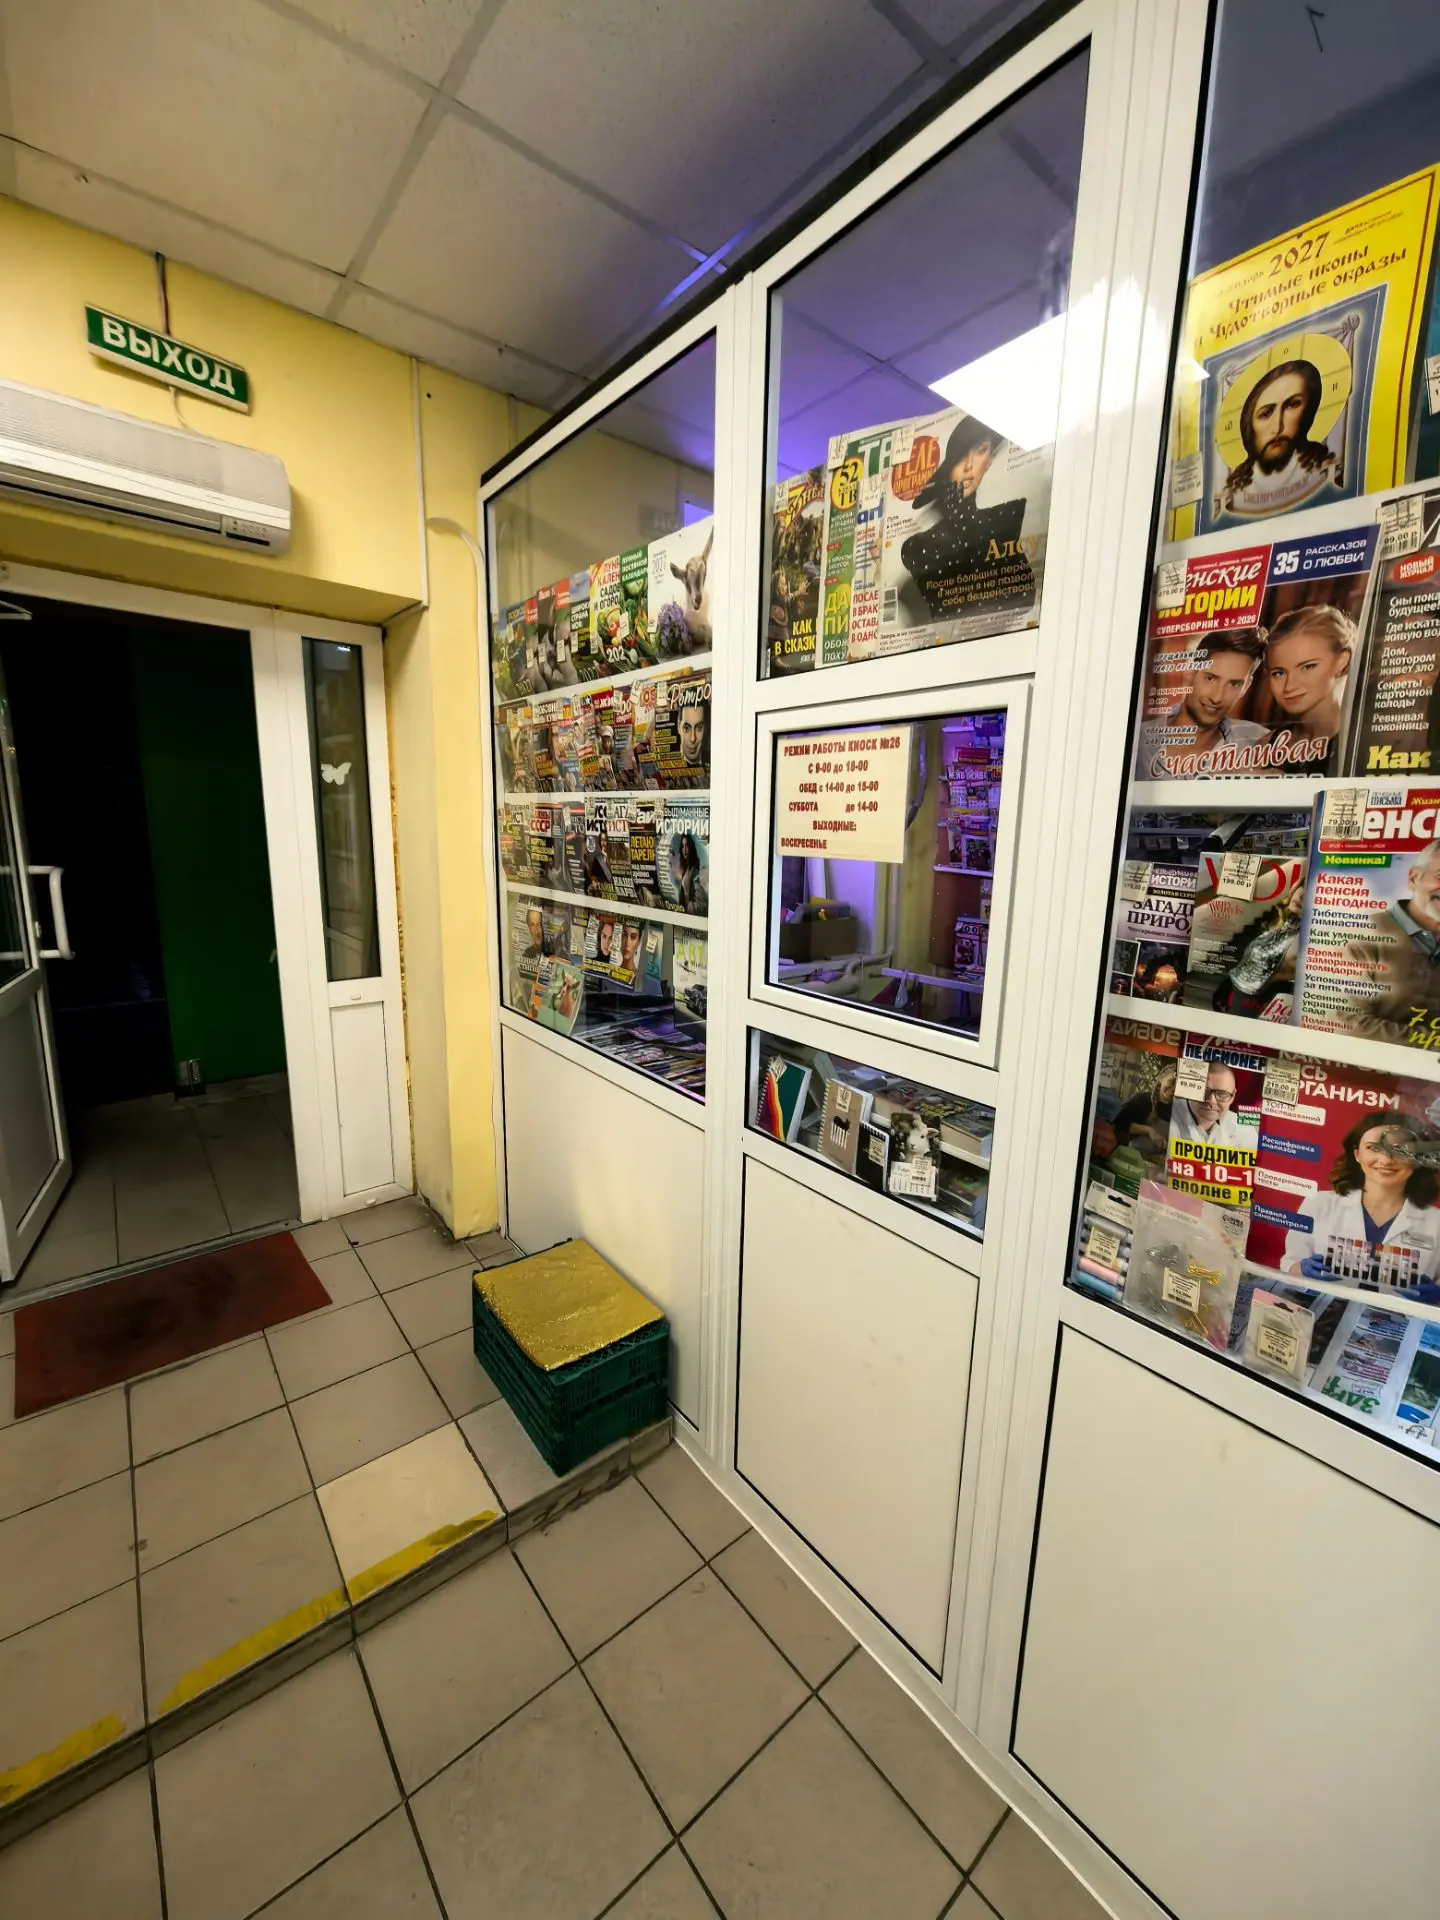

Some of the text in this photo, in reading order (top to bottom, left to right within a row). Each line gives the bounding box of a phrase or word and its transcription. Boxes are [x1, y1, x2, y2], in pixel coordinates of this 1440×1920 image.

[1268, 231, 1330, 278] 2027
[1229, 246, 1369, 313] Чтимые иконы
[102, 316, 235, 395] ВЫХОД
[839, 461, 858, 487] 52
[984, 535, 1040, 562] Алсу
[1305, 539, 1367, 556] РАССКАЗОВ
[1273, 550, 1300, 576] 35
[1314, 552, 1365, 568] ЛЮБВИ
[1400, 556, 1434, 572] НОВЫЙ
[926, 578, 955, 590] После
[957, 568, 998, 584] больших
[1186, 562, 1262, 588] енские
[984, 580, 995, 589] не
[853, 590, 878, 604] ПОСЛЕ
[942, 595, 965, 606] себе
[1390, 596, 1412, 607] Сны
[852, 604, 878, 616] В БРАК
[792, 618, 812, 636] КАК
[1156, 619, 1219, 635] СУПЕРСБОРНИК
[1386, 622, 1403, 633] Где
[852, 634, 856, 643] В
[1385, 630, 1422, 642] живую
[774, 635, 816, 655] В СКАЗК
[824, 651, 848, 662] ПОХУ
[1382, 647, 1408, 658] Дом,
[1389, 654, 1436, 667] котором
[1379, 663, 1434, 676] живет зло
[1377, 679, 1422, 692] Секреты
[1376, 687, 1433, 701] карточной
[1375, 698, 1415, 709] колоды
[1372, 712, 1424, 723] Ревнивая
[1371, 721, 1430, 732] покойница
[784, 743, 810, 757] РЕЖИМ
[813, 741, 845, 755] РАБОТЫ
[848, 738, 877, 752] КИОСК
[1151, 731, 1329, 778] Счастливая
[1366, 745, 1432, 769] Как
[833, 763, 843, 775] до
[846, 760, 868, 772] 18-00
[799, 781, 879, 794] ОБЕД с 14-00 до 15-00
[788, 801, 878, 813] СУББОТА до 14-00
[656, 818, 709, 836] ИСТОРИИ
[813, 820, 857, 832] ВЫХОДНЫЕ:
[781, 838, 827, 850] ВОСКРЕСЕНЬЕ
[1325, 855, 1386, 865] Новинка!
[1150, 874, 1197, 889] ИСТОРИ
[1317, 873, 1363, 885] Какая
[1315, 885, 1370, 897] пенсия
[1313, 896, 1388, 909] выгоднее
[1312, 908, 1369, 920] Тибетская
[1127, 910, 1191, 933] ПРИРО
[1311, 918, 1377, 929] гимнастика
[1308, 937, 1348, 947] живот?
[1309, 928, 1397, 943] Как уменьшить
[1307, 947, 1343, 958] Время
[1305, 964, 1363, 976] помидоры
[1306, 956, 1389, 972] замораживать
[1304, 974, 1392, 992] Успокаиваемся
[1303, 991, 1348, 1004] Осеннее
[1319, 984, 1342, 993] пять
[1344, 987, 1379, 999] минут
[1302, 1000, 1361, 1013] украшение
[1302, 1006, 1326, 1017] сада
[1408, 1006, 1428, 1027] 7
[1185, 1044, 1267, 1071] ПЕНСИОНЕР
[1301, 1065, 1327, 1081] СЬ
[1298, 1080, 1400, 1110] РГАНИЗМ
[1264, 1107, 1321, 1123] обследований
[1261, 1142, 1297, 1154] анализов
[1262, 1135, 1315, 1153] Расшифровка
[1175, 1141, 1257, 1167] ПРОДЛИТЬ
[1172, 1161, 1194, 1177] на
[1258, 1171, 1312, 1190] Проверочные
[1172, 1179, 1231, 1199] вполне
[1254, 1205, 1287, 1219] Правила
[1253, 1211, 1309, 1230] самоконтроля
